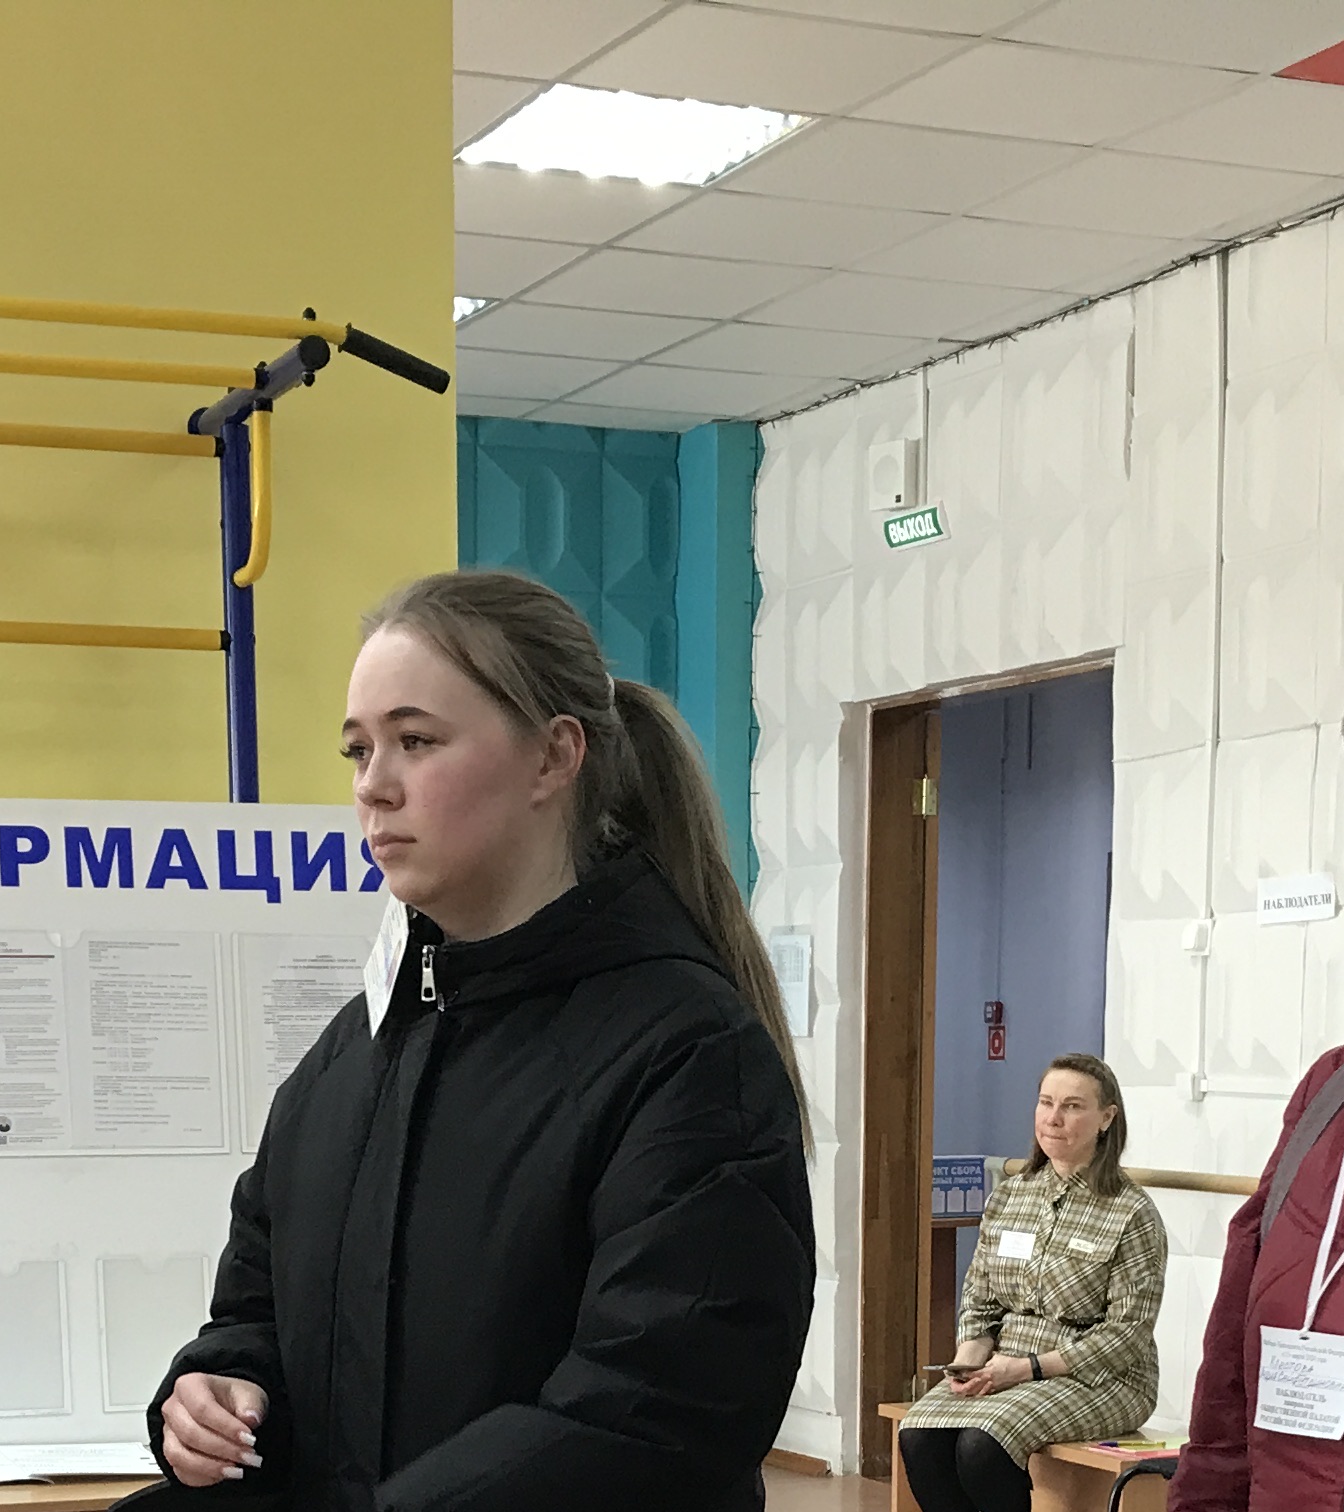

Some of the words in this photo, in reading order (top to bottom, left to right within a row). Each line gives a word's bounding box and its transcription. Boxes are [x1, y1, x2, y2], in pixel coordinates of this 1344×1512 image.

[888, 512, 938, 544] ВЫХОД
[1263, 893, 1332, 910] НАБЛЮДАТЕЛИ
[951, 1165, 982, 1175] СБОРА
